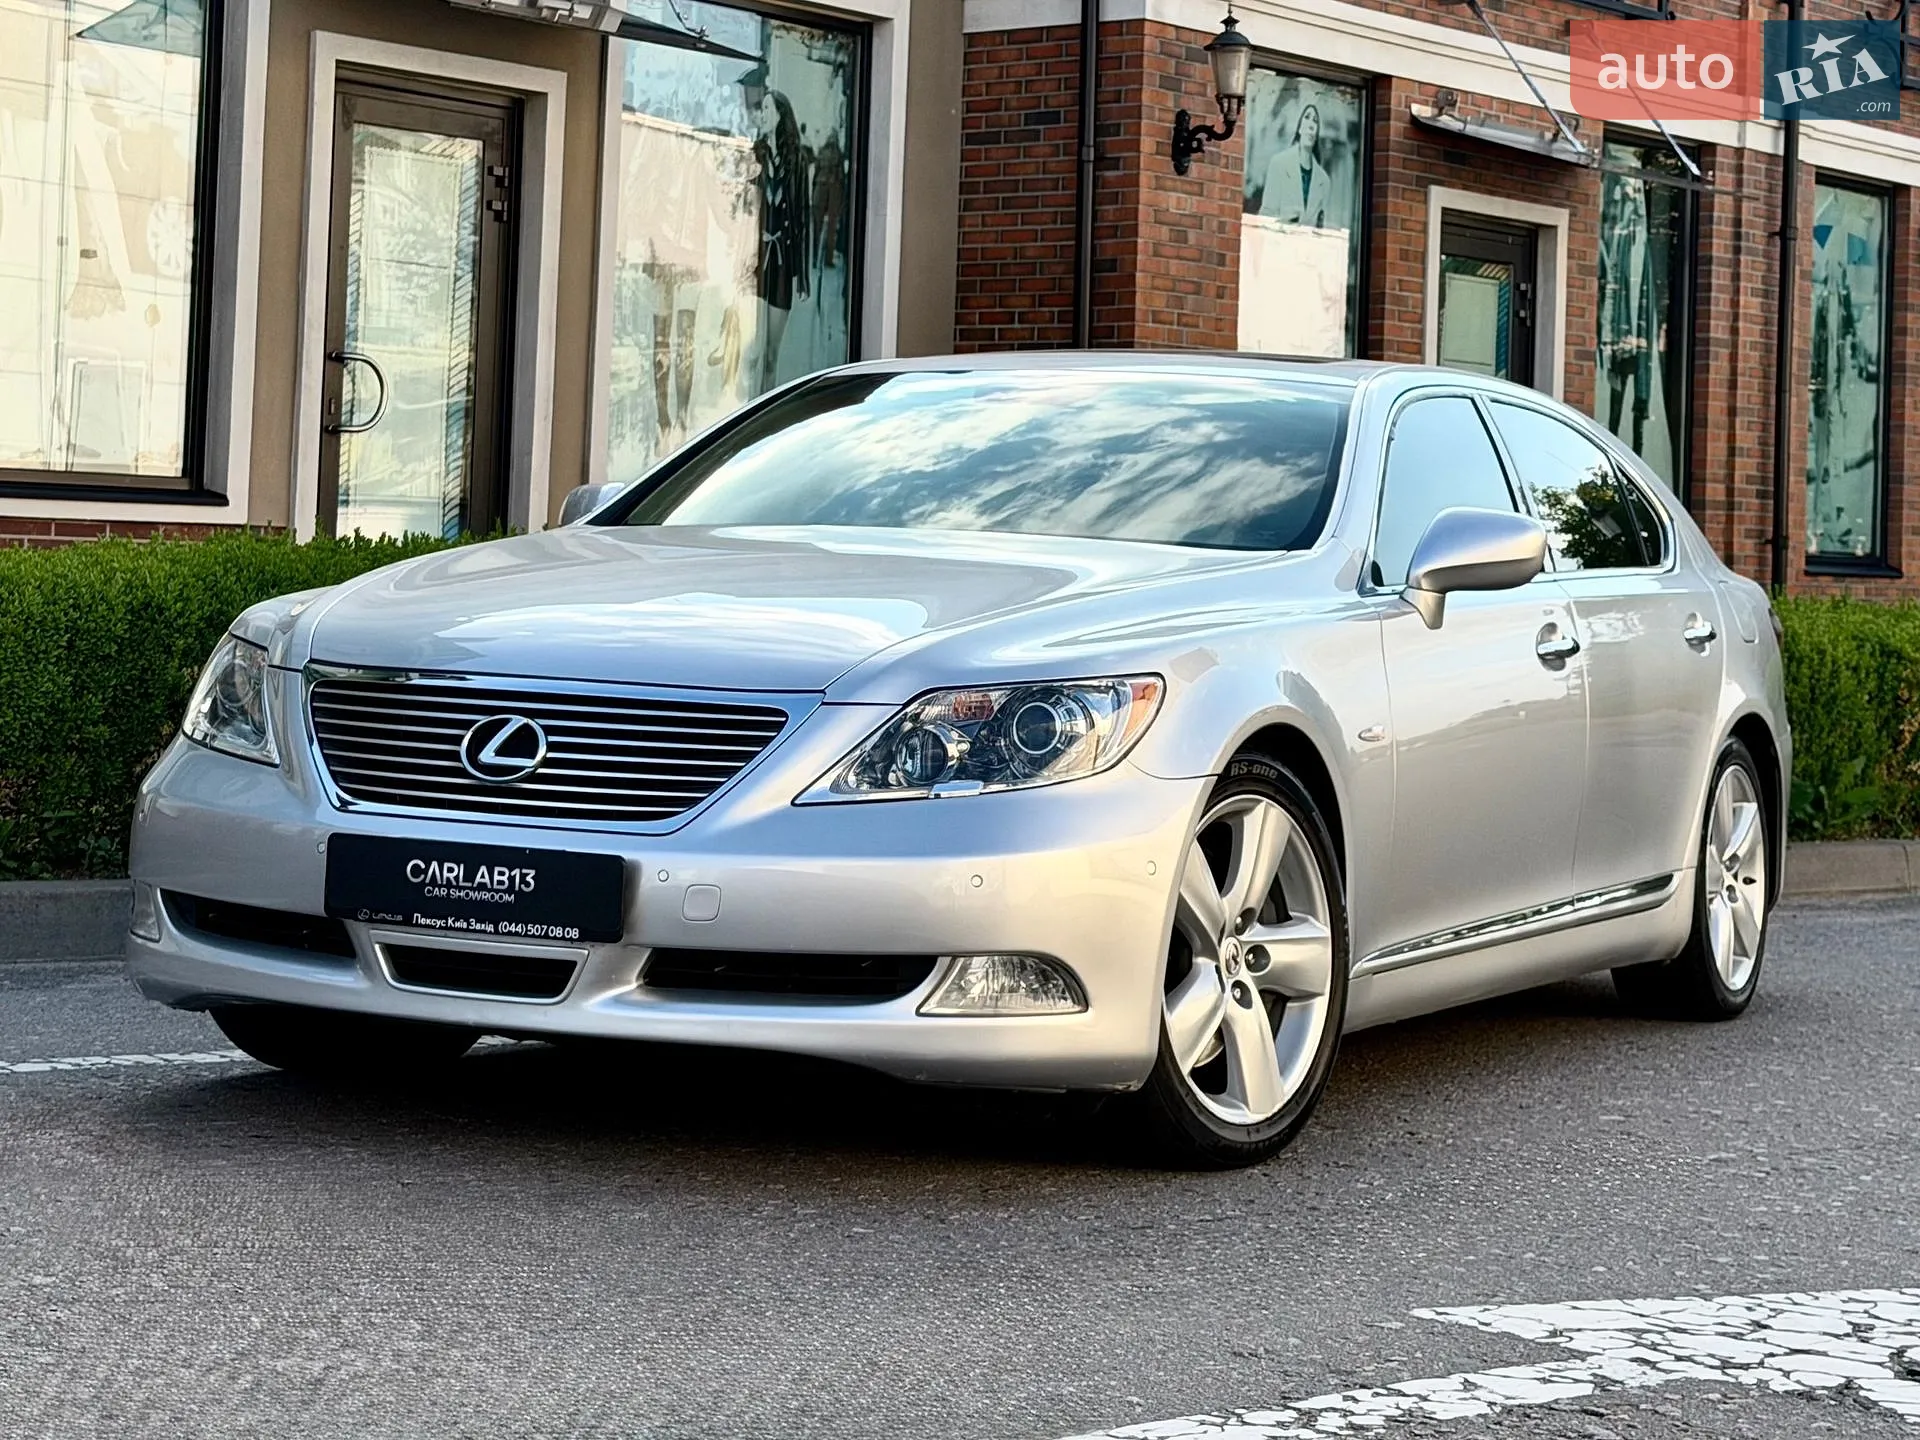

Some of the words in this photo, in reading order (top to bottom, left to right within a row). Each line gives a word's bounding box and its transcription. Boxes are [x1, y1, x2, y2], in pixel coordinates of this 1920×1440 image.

[406, 859, 536, 892] CARLAB13
[424, 886, 448, 898] CAR
[449, 888, 515, 904] SHOWROOM
[412, 912, 447, 928] Лексус
[498, 921, 526, 936] (044)
[527, 923, 548, 936] 507
[548, 926, 563, 938] 08
[564, 927, 580, 939] 08
